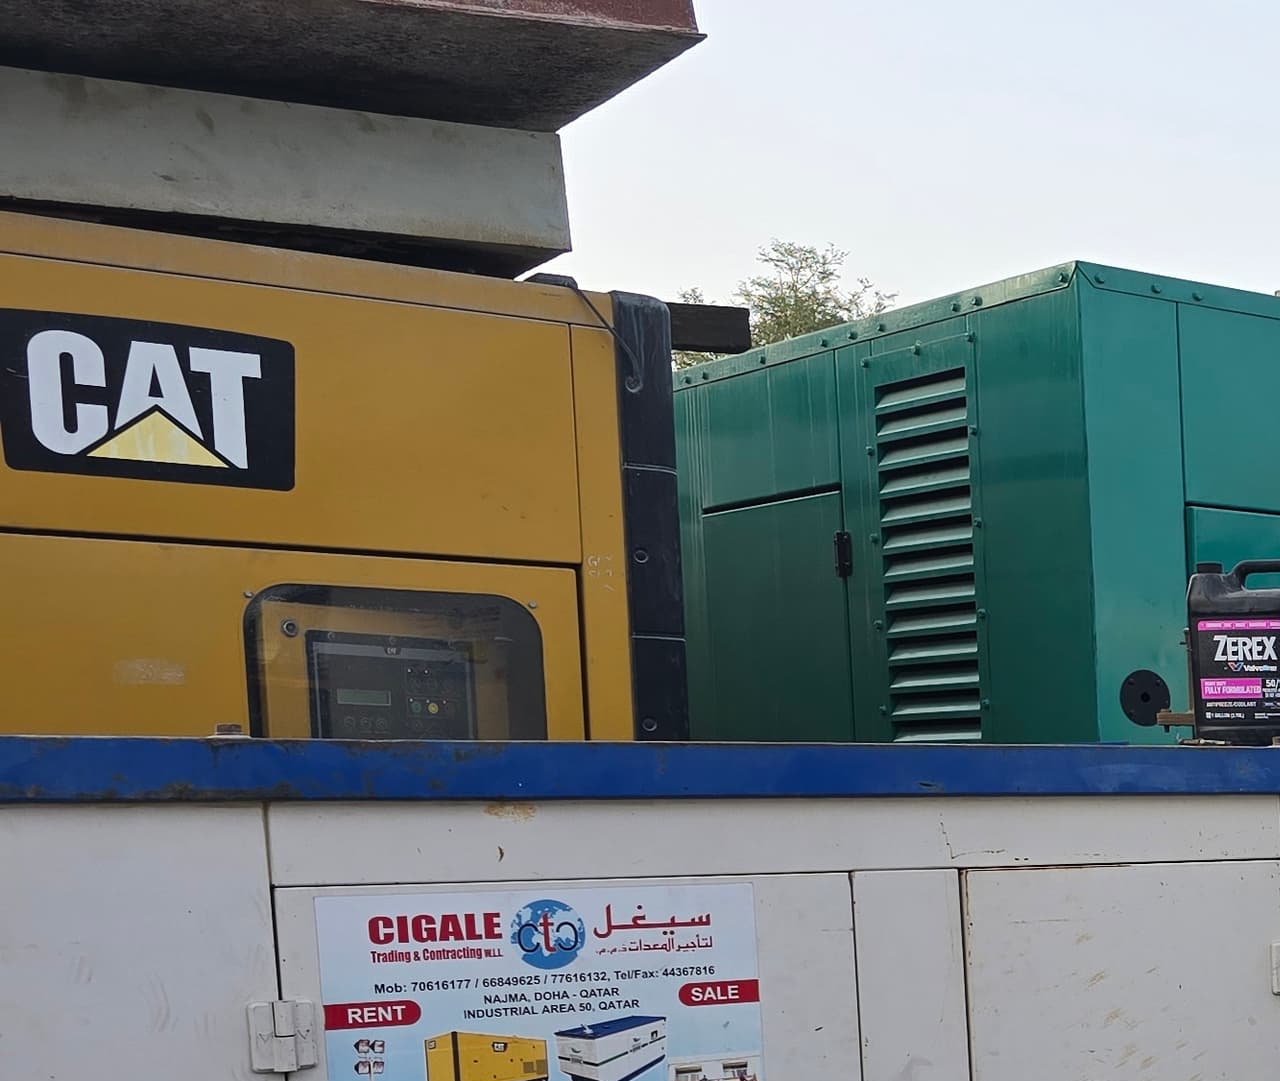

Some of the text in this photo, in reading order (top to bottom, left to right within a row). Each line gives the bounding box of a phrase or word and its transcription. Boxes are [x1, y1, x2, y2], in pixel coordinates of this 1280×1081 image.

[26, 329, 263, 470] CAT
[1213, 634, 1278, 661] ZEREX
[368, 912, 503, 945] CIGALE
[370, 951, 412, 964] Trading
[413, 951, 421, 962] &
[422, 946, 482, 961] Contracting
[374, 983, 407, 994] Mob:
[411, 979, 471, 992] 70616177
[482, 975, 541, 988] 66849625
[551, 971, 611, 984] 77616132,
[614, 969, 659, 980] Tel/Fax:
[662, 965, 715, 978] 44367816
[534, 991, 570, 1002] DOHA
[579, 987, 620, 999] QATAR
[690, 985, 740, 1002] SALE
[347, 1005, 406, 1024] RENT
[463, 1005, 539, 1019] INDUSTRIAL
[542, 1003, 576, 1015] AREA
[598, 999, 640, 1011] QATAR
